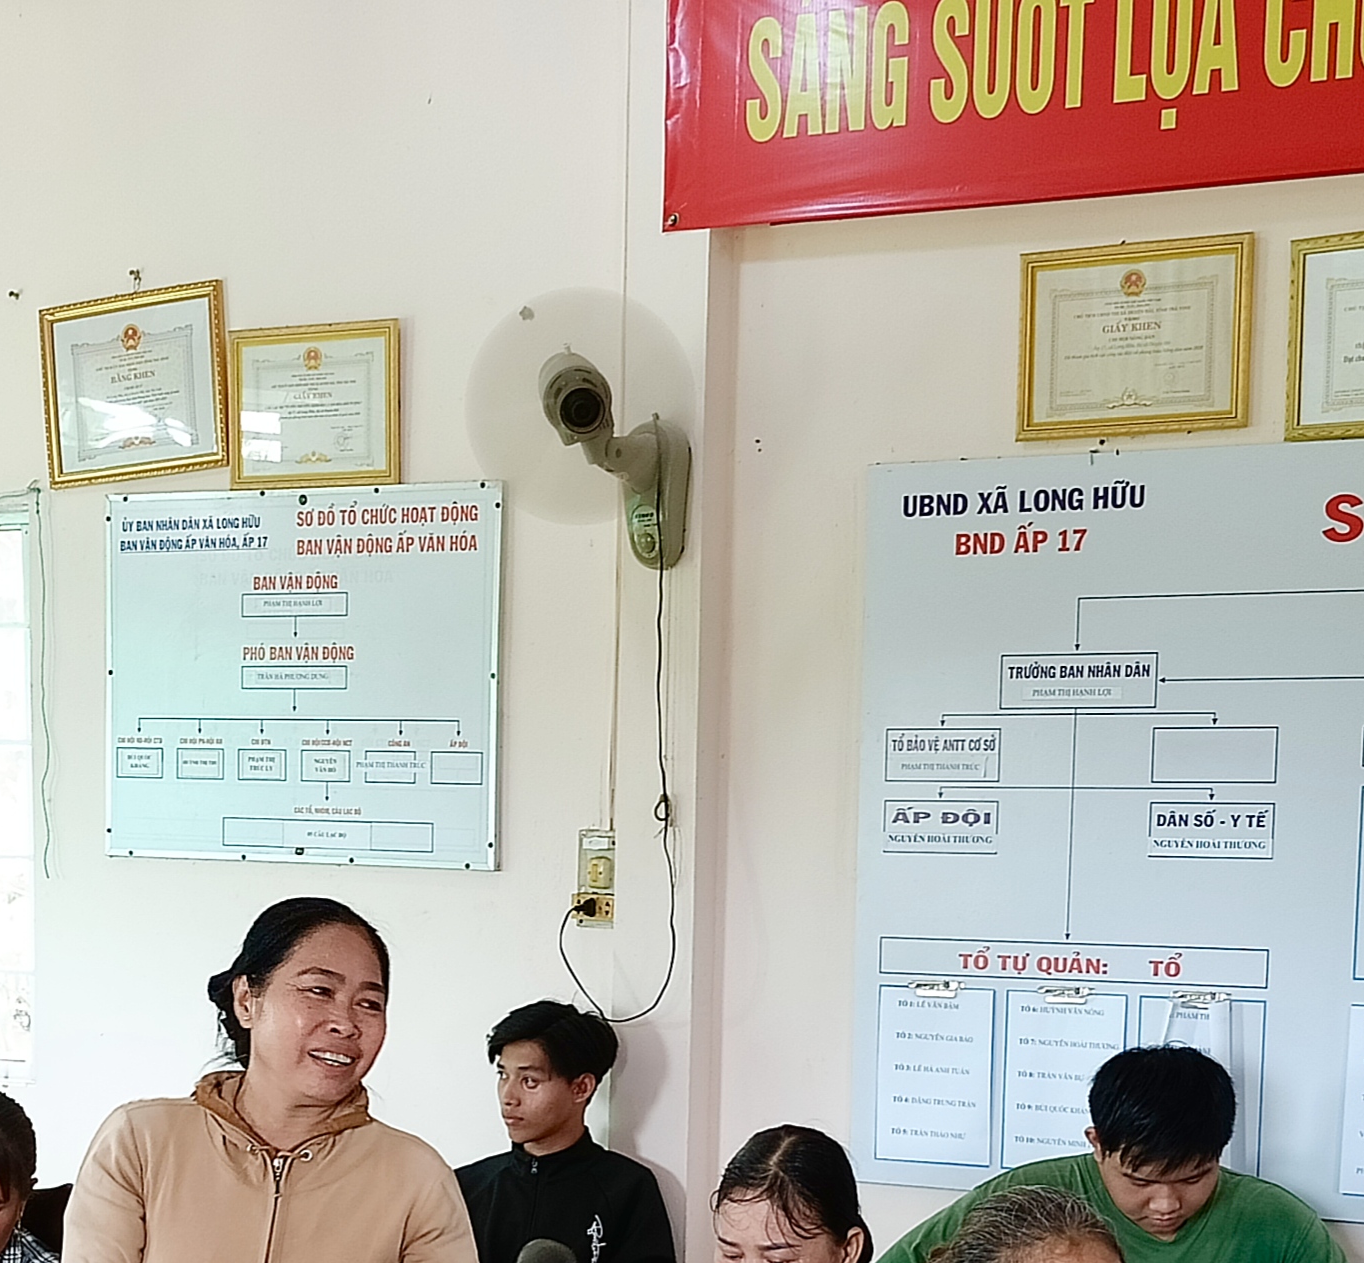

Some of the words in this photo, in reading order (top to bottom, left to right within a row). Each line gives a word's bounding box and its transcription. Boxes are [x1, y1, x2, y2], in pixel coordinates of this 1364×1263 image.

[902, 493, 969, 518] UBND
[976, 485, 1009, 515] XÃ
[1018, 487, 1085, 513] LONG
[1092, 479, 1146, 510] HỮU
[296, 507, 315, 528] SƠ
[317, 504, 336, 527] ĐỒ
[338, 504, 357, 526] TỔ
[360, 503, 398, 526] CHỨC
[400, 506, 437, 526] HOẠT
[440, 500, 479, 526] ĐỘNG
[296, 538, 323, 556] BAN
[326, 534, 353, 559] VẬN
[356, 532, 393, 558] ĐỘNG
[395, 530, 415, 554] ẤP
[417, 532, 446, 553] VĂN
[449, 529, 478, 552] HÓA
[955, 532, 1006, 556] BND
[1013, 523, 1049, 554] ẤP
[1057, 528, 1088, 552] 17
[891, 806, 932, 824] ẤP
[940, 808, 992, 828] ĐỘI
[1156, 810, 1190, 828] DÂN
[1193, 808, 1217, 828] SỐ
[1230, 814, 1242, 828] Y
[1245, 809, 1270, 829] TẾ
[957, 945, 991, 971] TỔ
[996, 952, 1031, 975] TỰ
[1036, 950, 1109, 976] QUẢN:
[1148, 952, 1183, 978] TỔ
